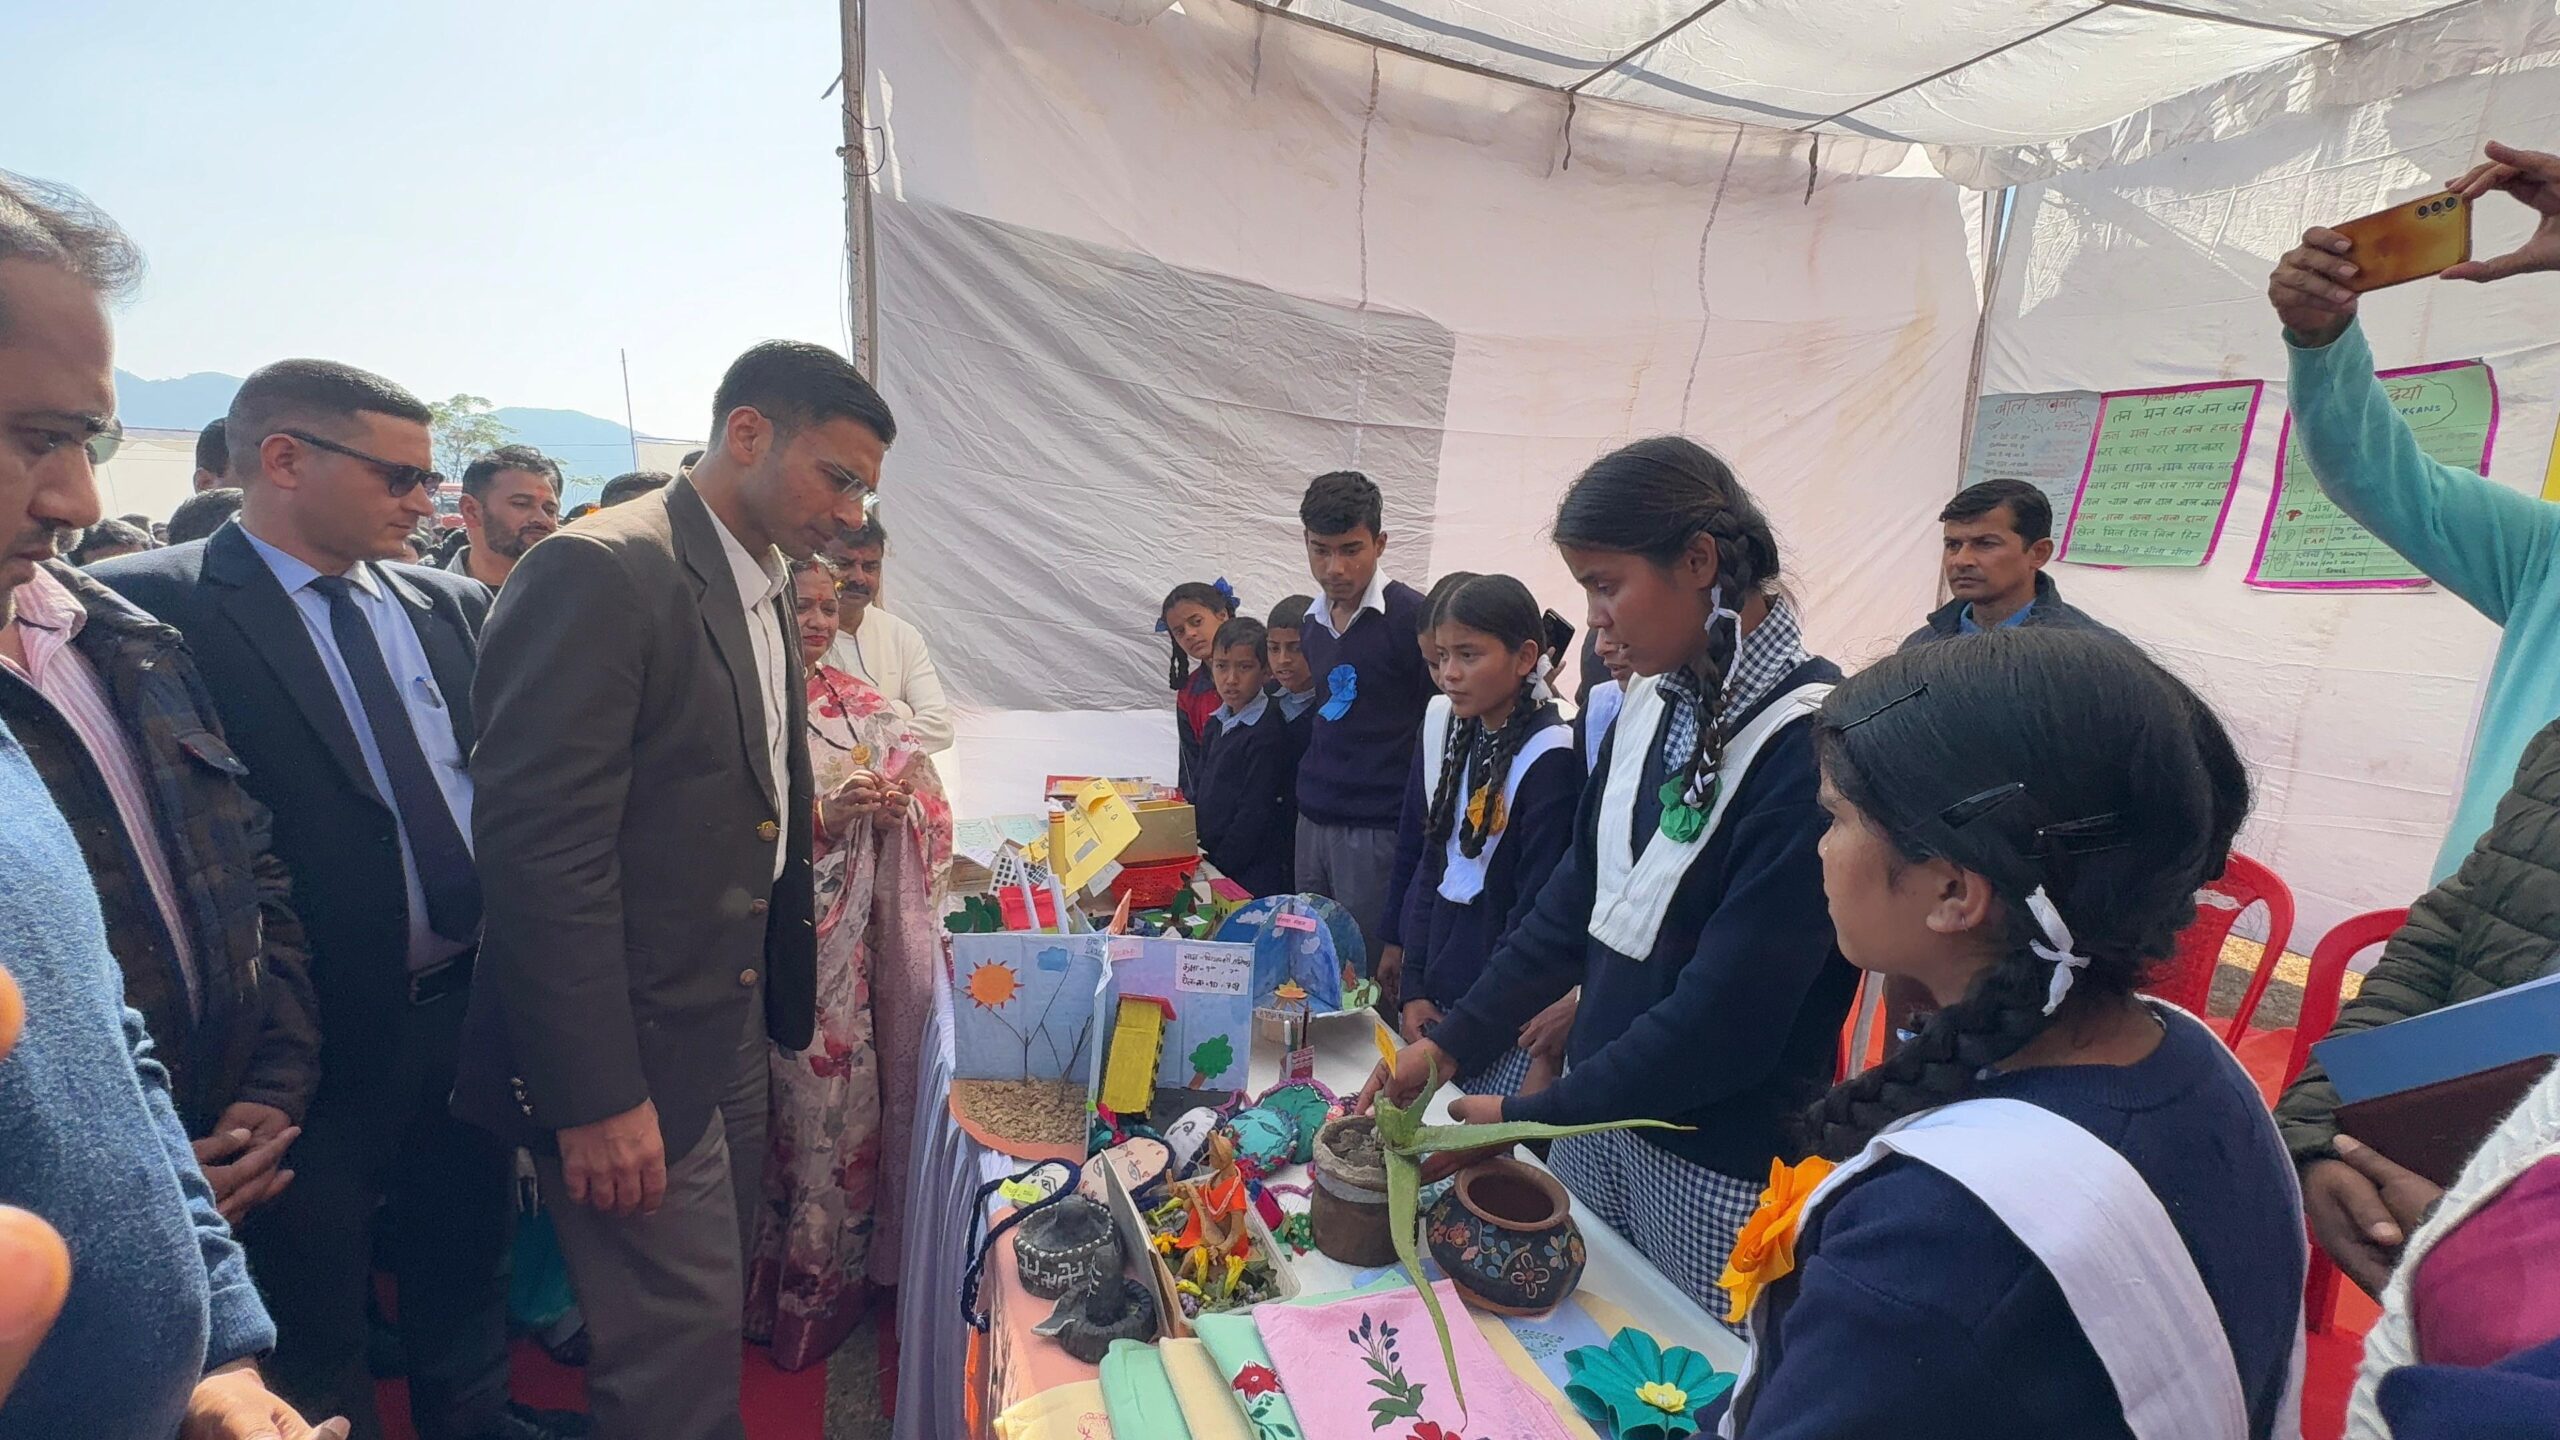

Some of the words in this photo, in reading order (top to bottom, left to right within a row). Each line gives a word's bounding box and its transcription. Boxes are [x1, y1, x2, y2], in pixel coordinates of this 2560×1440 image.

[2113, 410, 2132, 423] तन
[2144, 407, 2168, 420] मन
[2172, 404, 2196, 417] धन
[2198, 402, 2223, 415] जन
[2398, 405, 2441, 416] RGANS
[2281, 482, 2290, 493] 2
[2303, 537, 2326, 545] EAR
